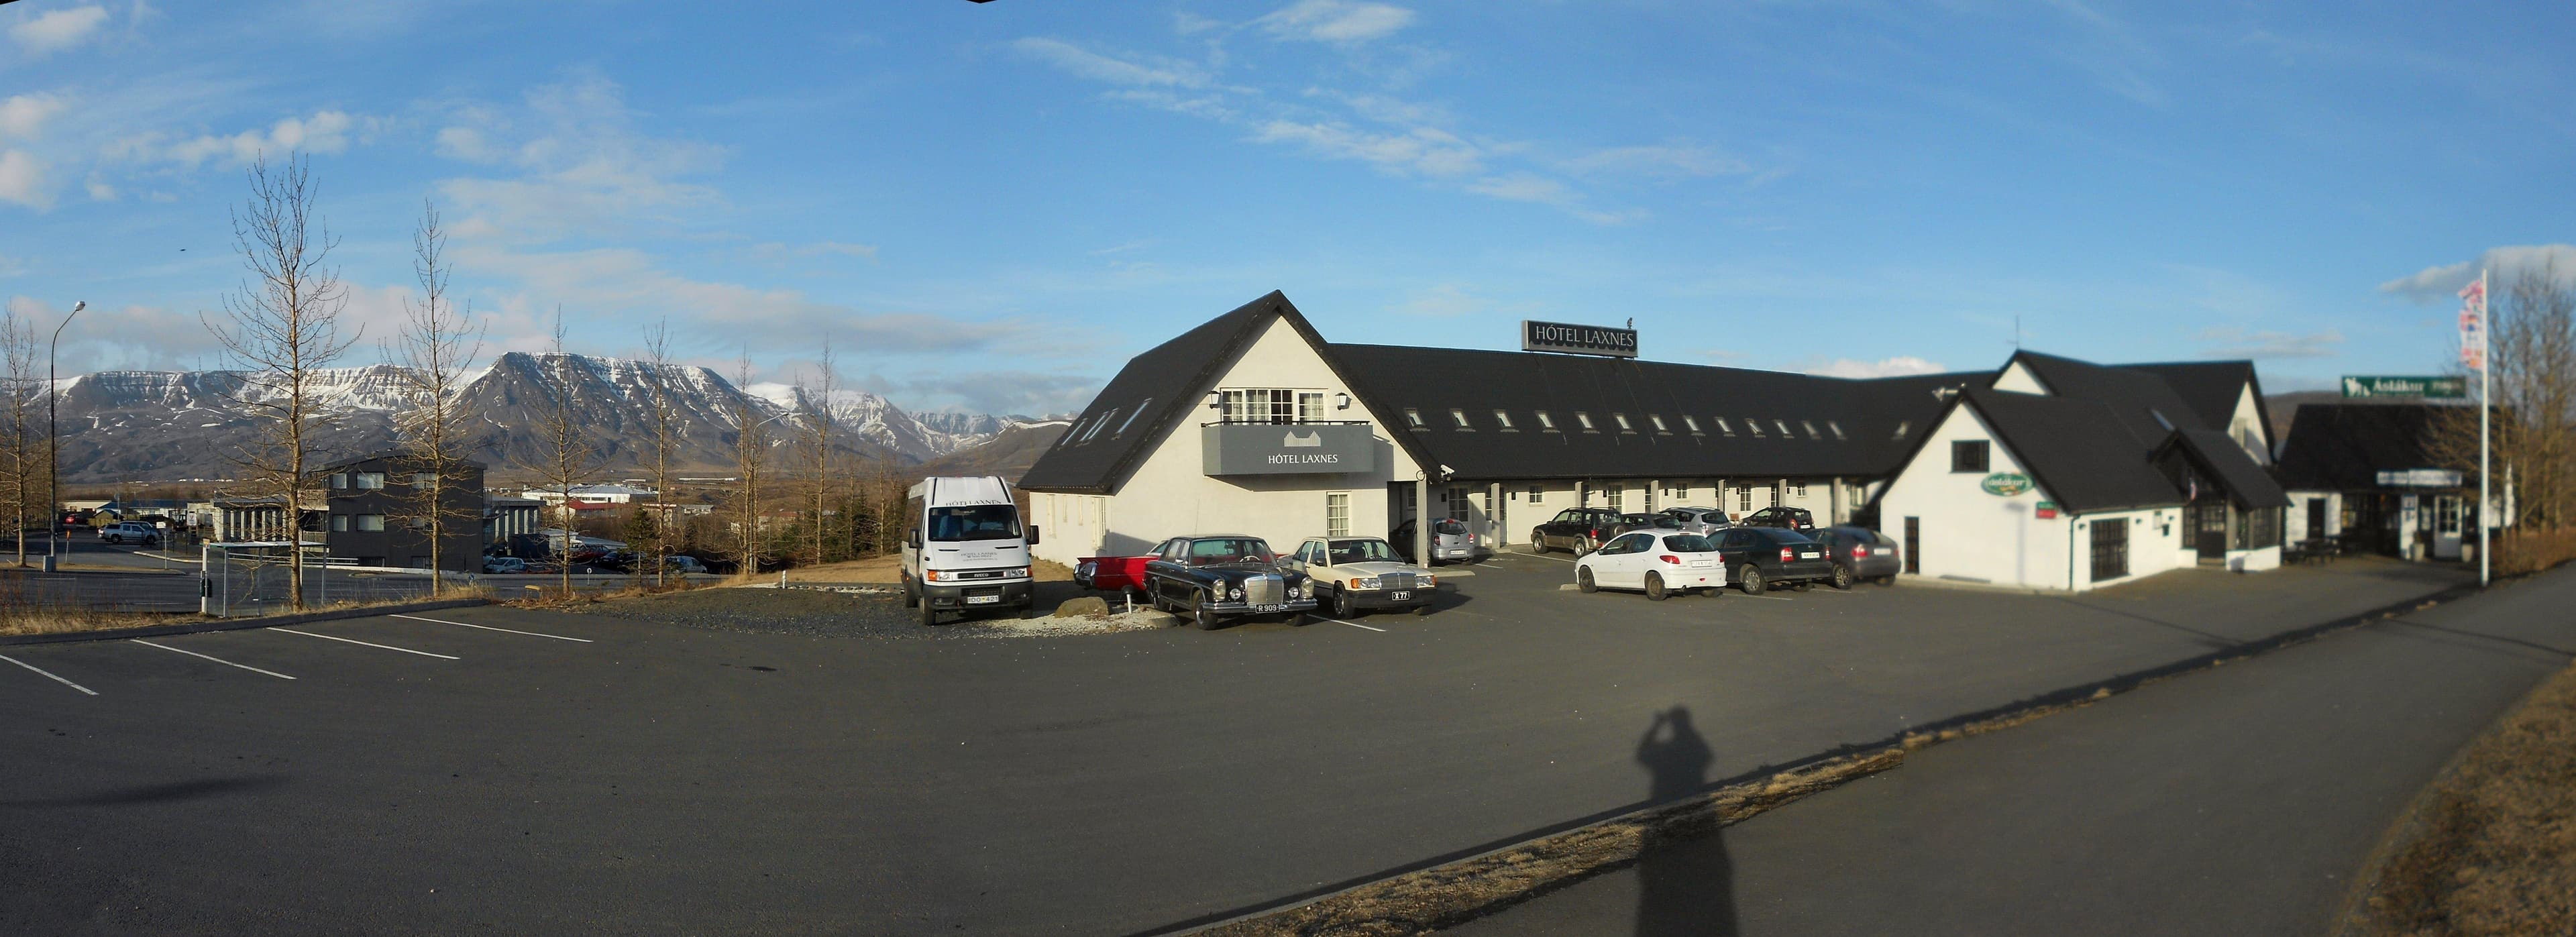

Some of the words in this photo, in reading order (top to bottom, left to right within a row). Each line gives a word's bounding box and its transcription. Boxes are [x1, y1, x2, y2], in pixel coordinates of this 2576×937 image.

[1536, 325, 1580, 342] HÓTEL
[1585, 330, 1633, 347] LAXNES
[1268, 453, 1299, 464] HÓTEL
[1302, 454, 1338, 463] LAXNES
